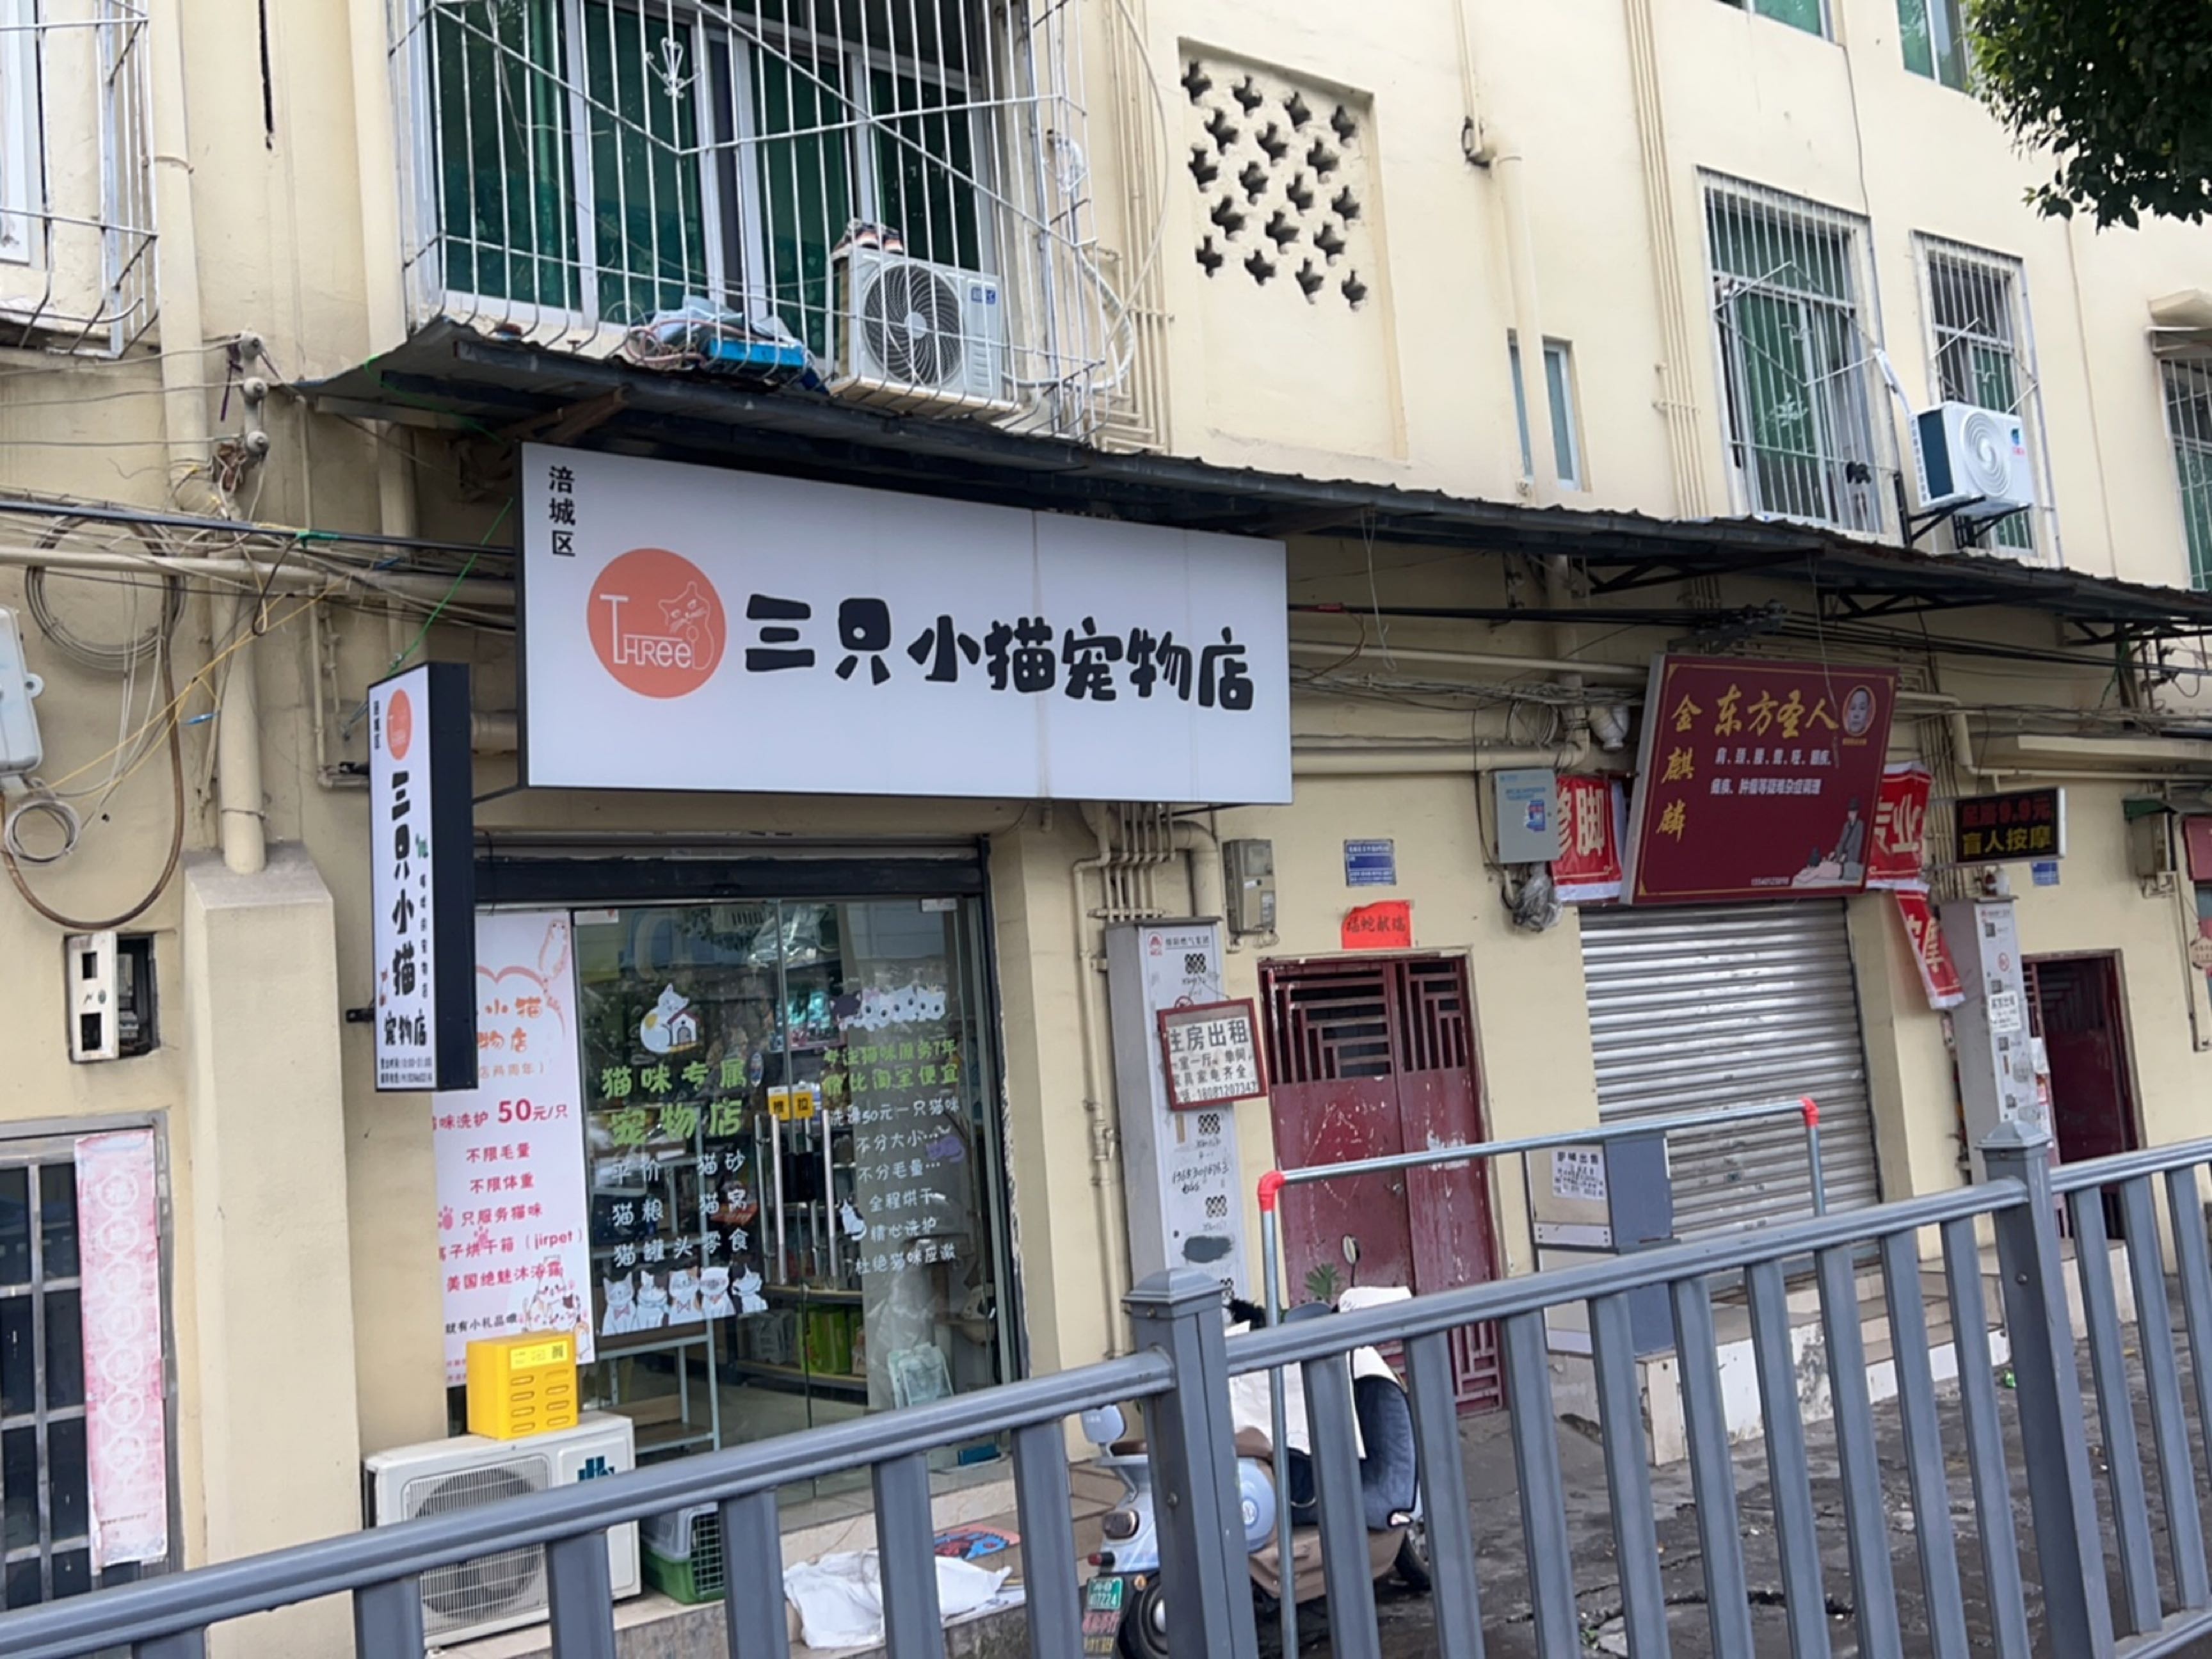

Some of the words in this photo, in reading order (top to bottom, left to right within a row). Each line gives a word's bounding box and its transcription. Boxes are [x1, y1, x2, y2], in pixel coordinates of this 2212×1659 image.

[548, 466, 576, 557] 涪城区
[745, 593, 1254, 711] 三只小猫宠物店
[1713, 683, 1839, 739] 东方圣人
[1656, 694, 1703, 843] 金麒麟
[1962, 825, 2051, 856] 盲人按摩
[391, 770, 415, 997] 三只小猫
[477, 996, 542, 1018] 小猫
[385, 1009, 426, 1046] 宠物店
[602, 1059, 748, 1098] 猫咪专属
[433, 1110, 488, 1130] 咪洗护
[497, 1098, 568, 1123] 50元/只
[608, 1099, 743, 1146] 宠物店
[466, 1142, 531, 1164] 不限毛量
[612, 1159, 661, 1185] 平价
[696, 1150, 746, 1177] 猫砂
[470, 1172, 534, 1194] 不限体重
[869, 1187, 933, 1213] 全程烘干
[461, 1202, 543, 1227] 只服务猫咪
[612, 1196, 664, 1228] 猫粮
[698, 1188, 748, 1215] 猫窝
[613, 1237, 693, 1268] 猫罐头
[702, 1227, 749, 1254] 零食
